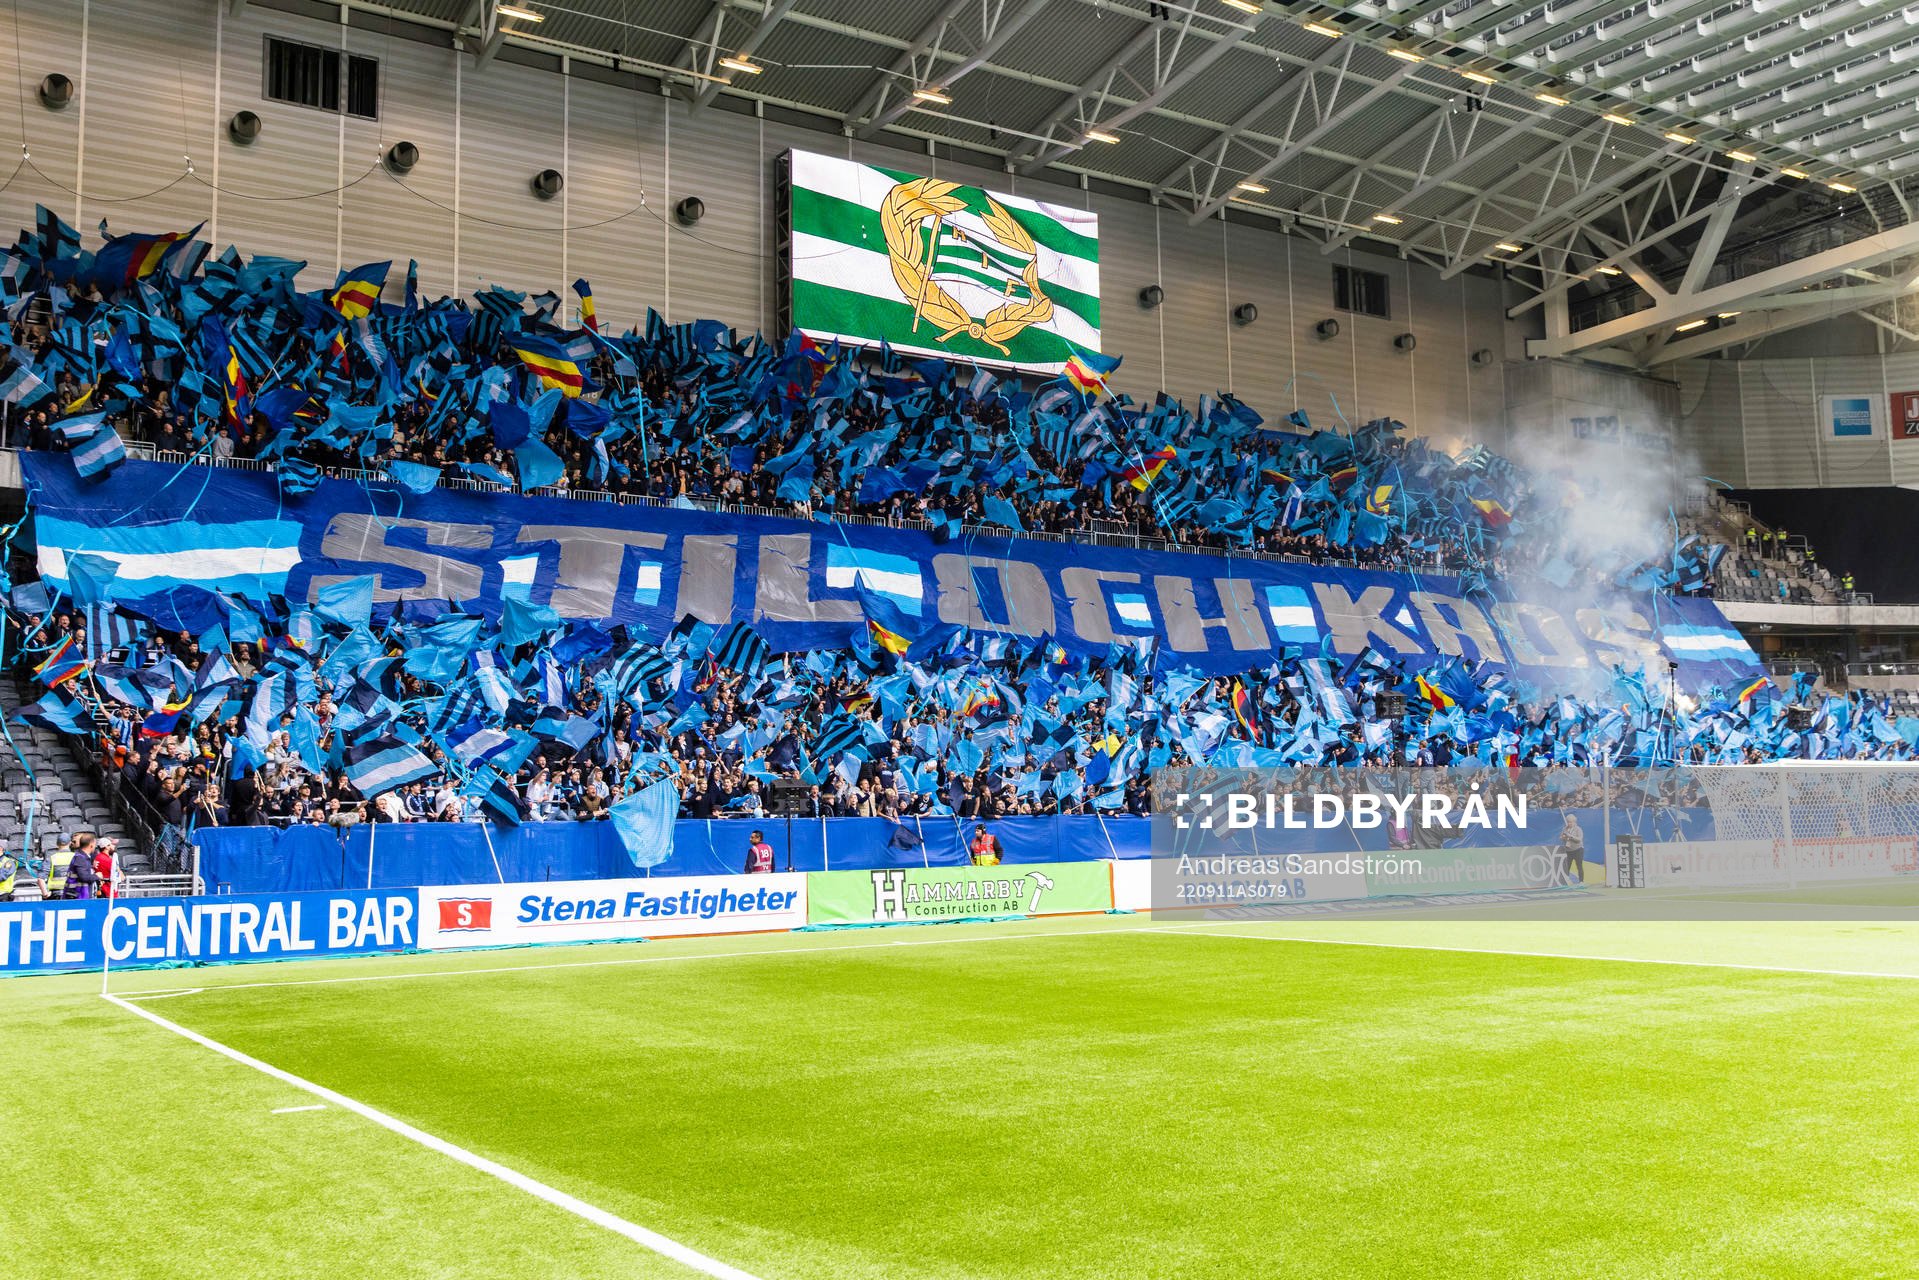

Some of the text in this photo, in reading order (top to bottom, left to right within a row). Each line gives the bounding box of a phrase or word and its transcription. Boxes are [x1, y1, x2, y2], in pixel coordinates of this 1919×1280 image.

[307, 512, 868, 624] STIL
[1619, 842, 1630, 888] SELECT
[517, 887, 797, 922] Stena Fastigheter
[871, 869, 1025, 921] HAMMARBY
[915, 900, 1019, 916] Construction AB
[0, 897, 413, 966] THE CENTRAL BAR
